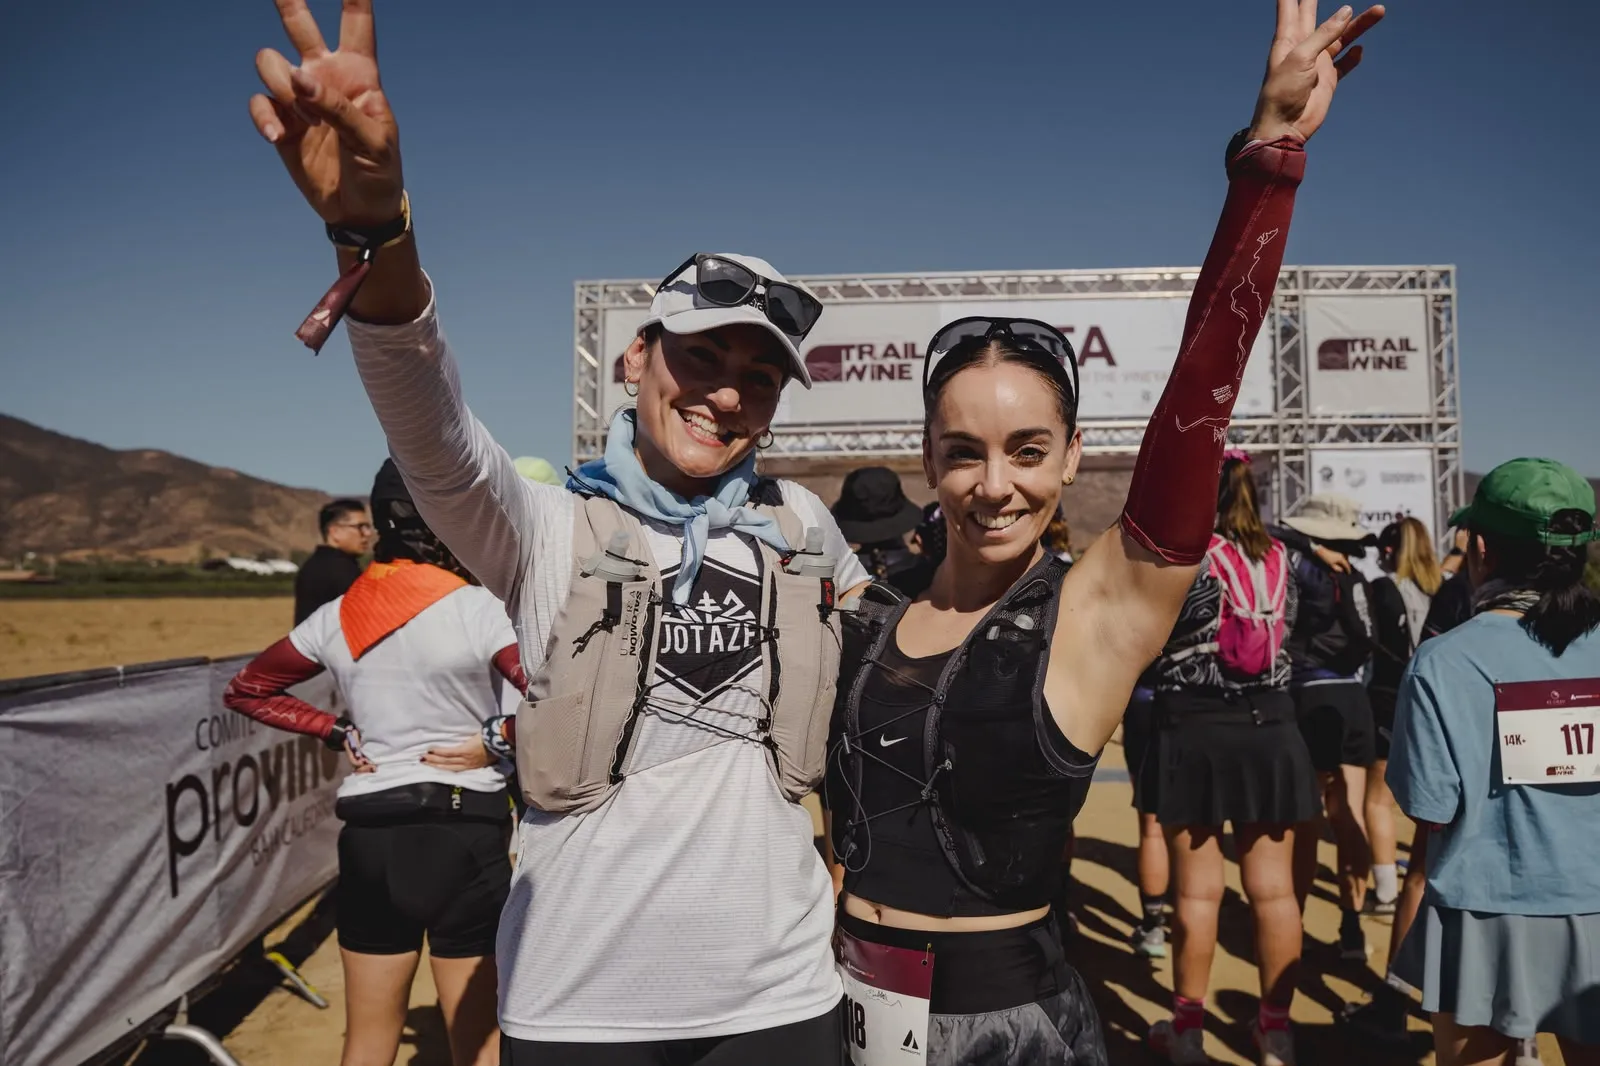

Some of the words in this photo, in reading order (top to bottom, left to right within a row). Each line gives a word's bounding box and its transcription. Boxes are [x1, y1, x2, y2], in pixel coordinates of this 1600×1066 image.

[841, 342, 924, 361] TRAIL
[1348, 337, 1418, 352] TRAIL
[1351, 355, 1408, 370] WINE
[845, 364, 912, 381] WINE
[629, 590, 642, 656] SALOMON
[1560, 722, 1595, 756] 117
